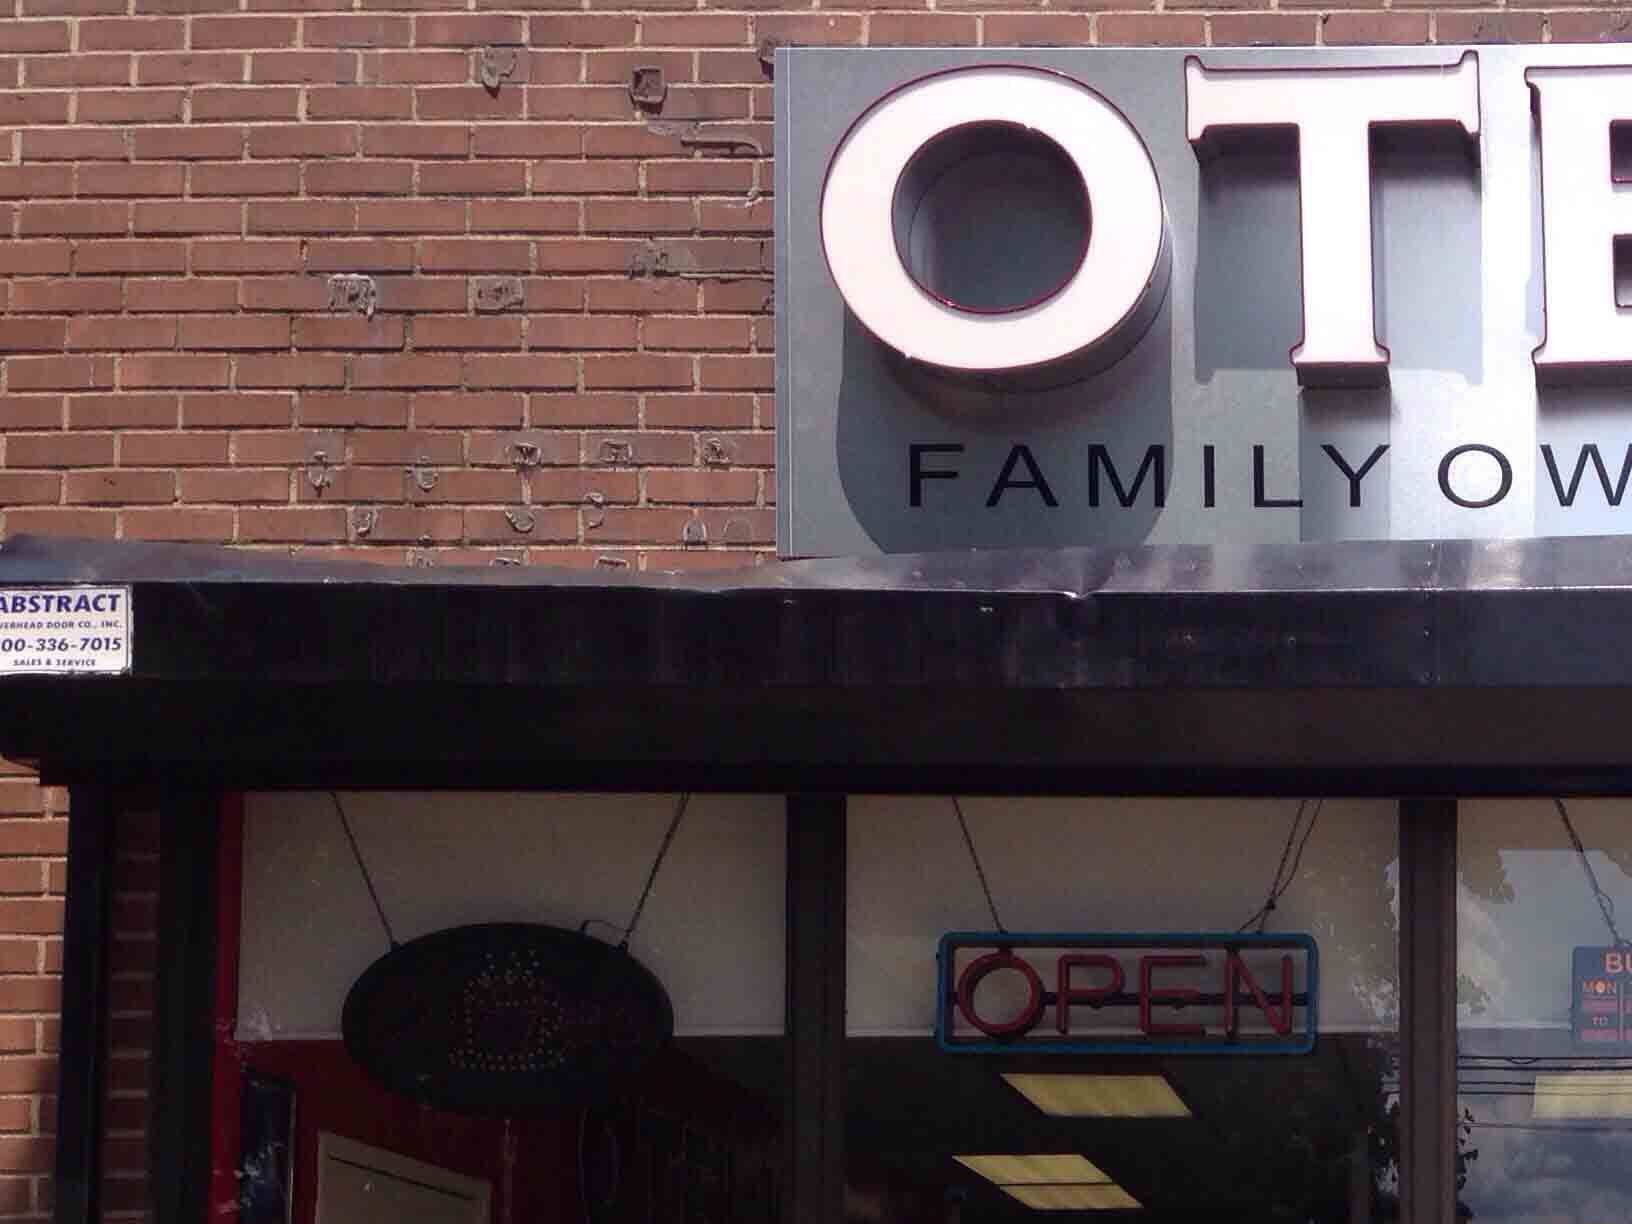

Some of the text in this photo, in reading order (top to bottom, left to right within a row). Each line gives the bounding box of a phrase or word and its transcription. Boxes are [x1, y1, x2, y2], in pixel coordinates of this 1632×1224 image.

[909, 444, 1390, 508] FAMILY
[0, 593, 121, 613] ABSTRACT
[957, 949, 1293, 1036] OPEN
